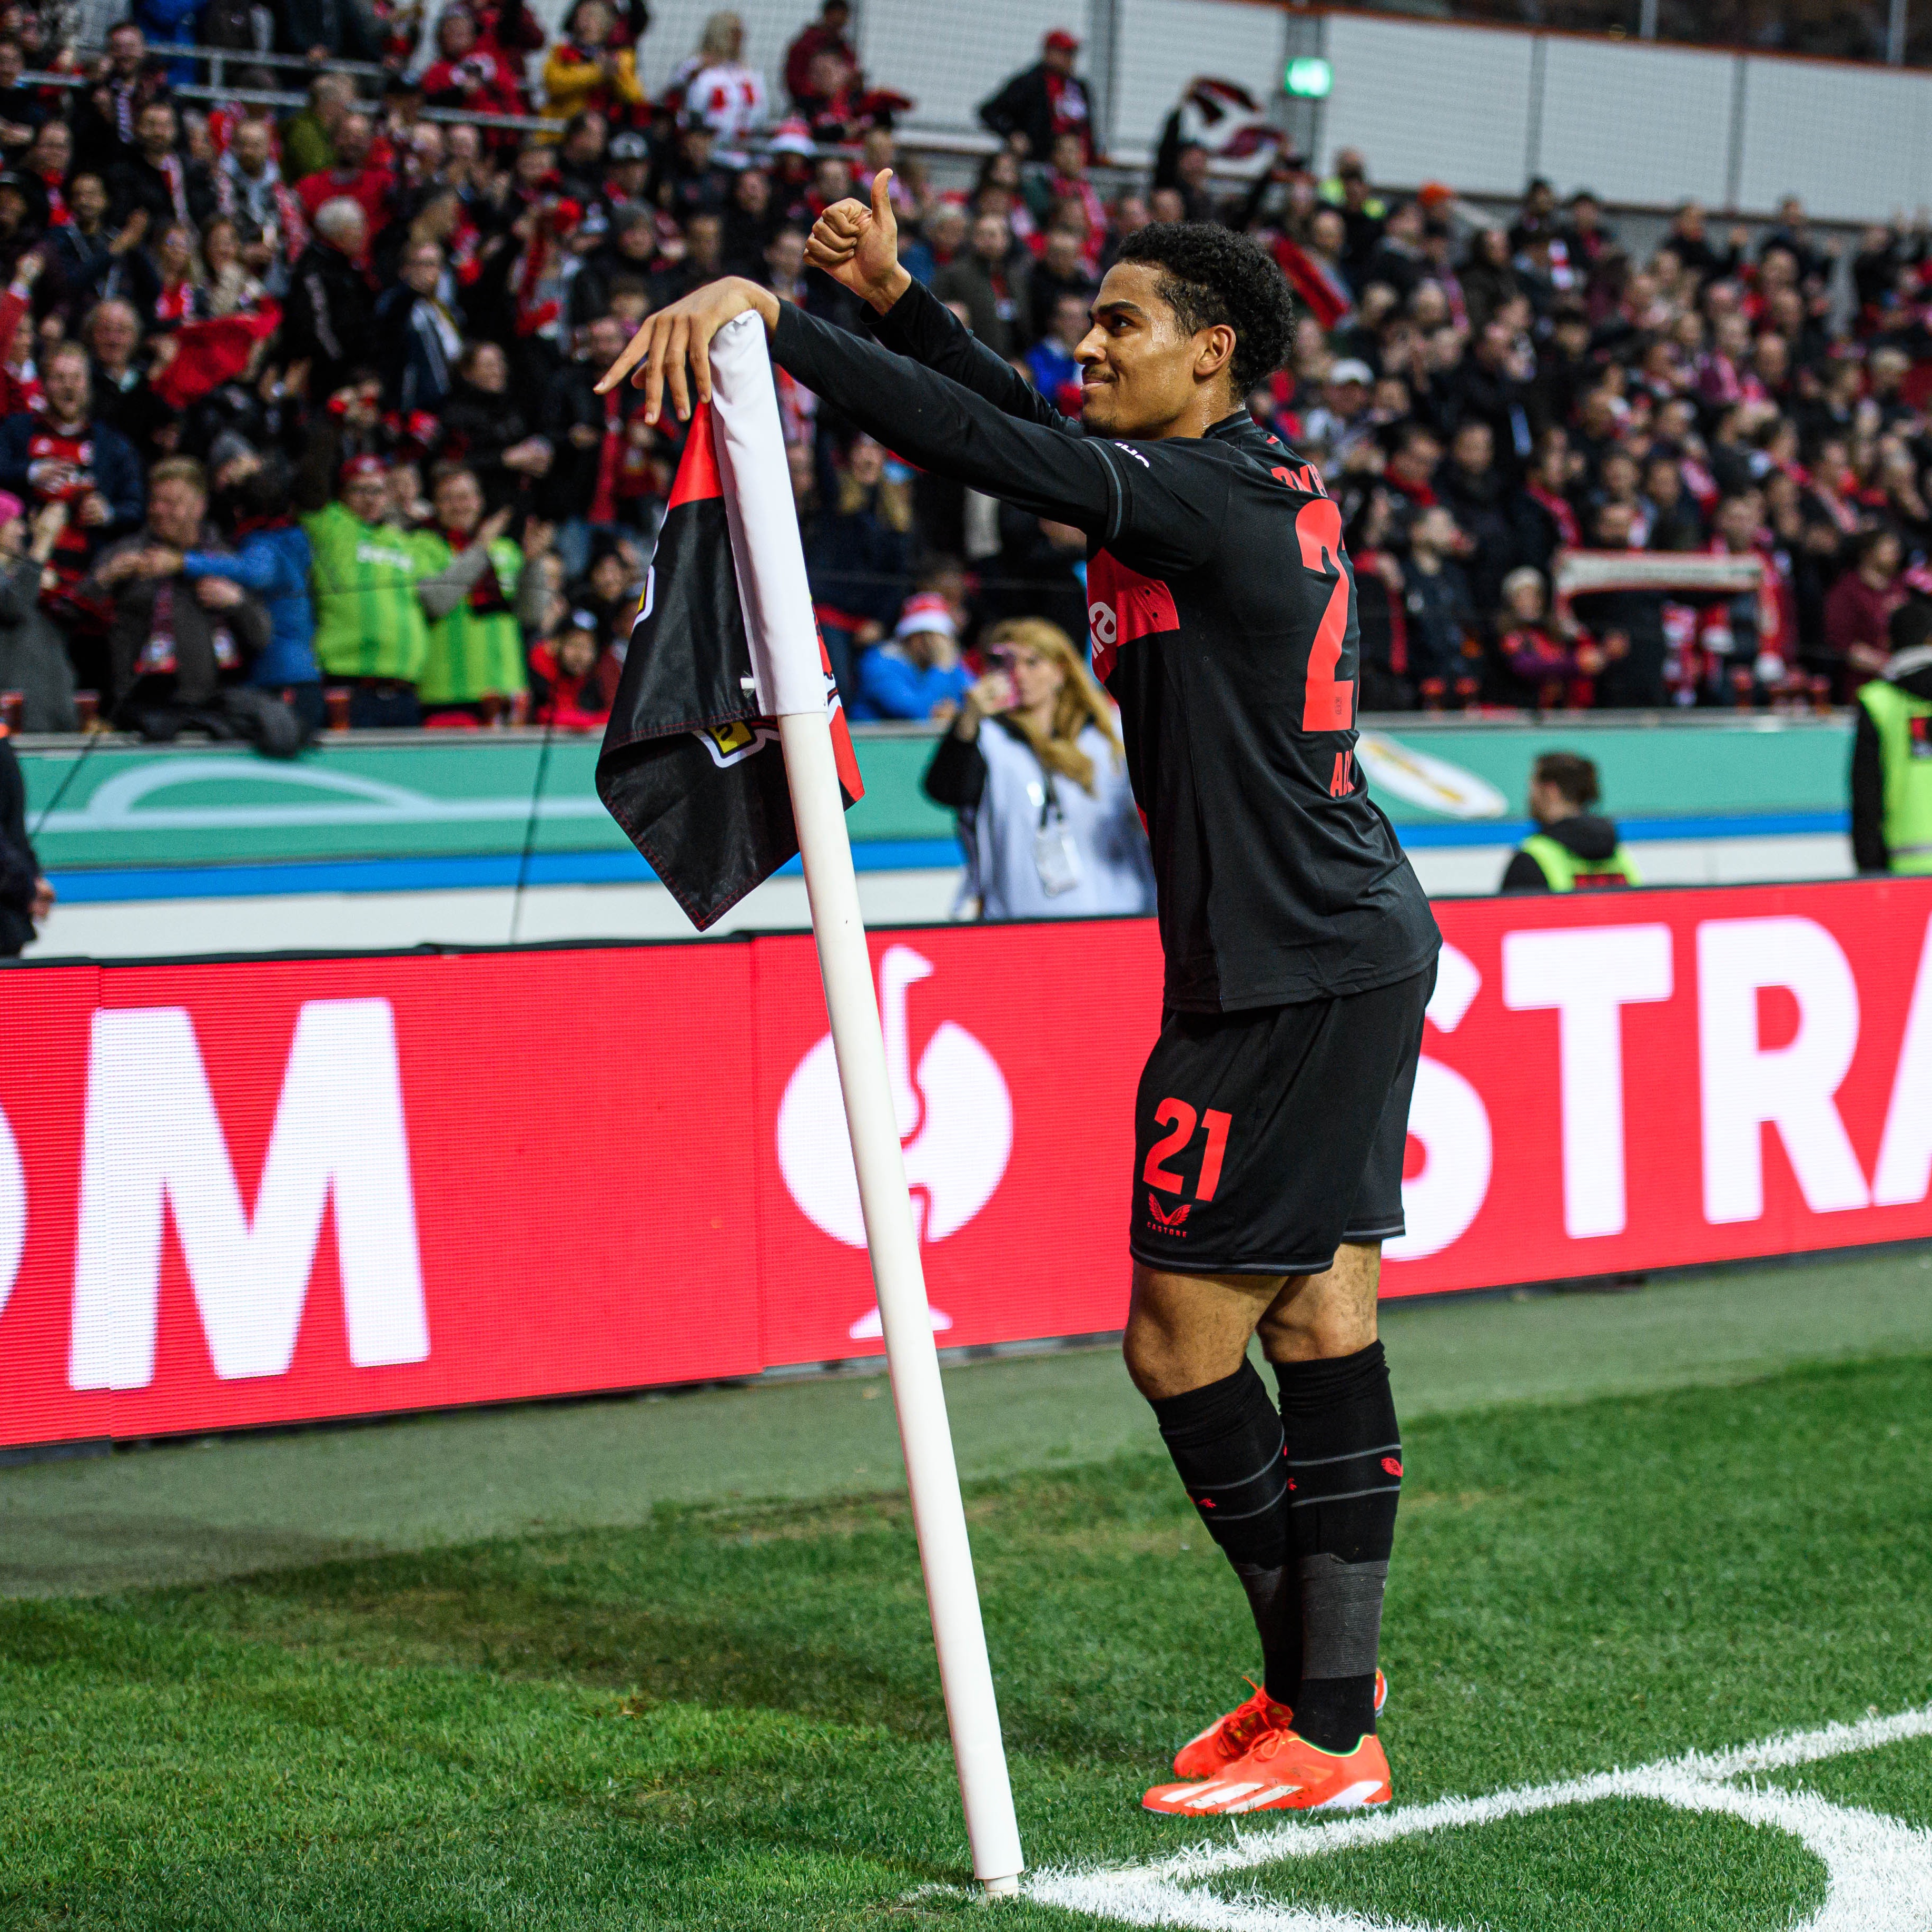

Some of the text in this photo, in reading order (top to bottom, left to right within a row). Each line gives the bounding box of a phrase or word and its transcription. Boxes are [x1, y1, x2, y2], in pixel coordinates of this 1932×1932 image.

[0, 997, 431, 1392] M
[1143, 1097, 1233, 1202] 21
[1147, 1221, 1187, 1238] CASTORE
